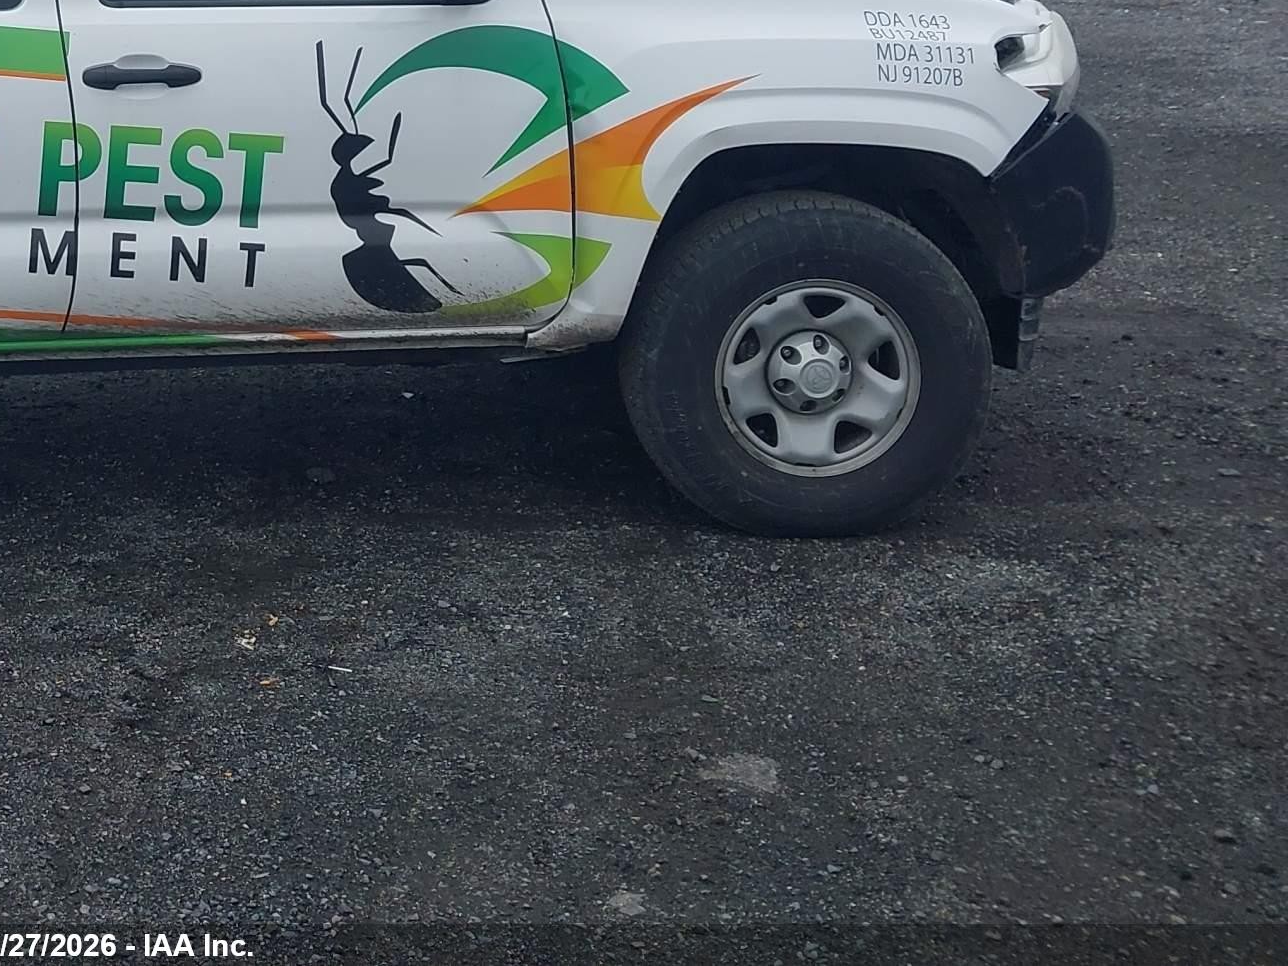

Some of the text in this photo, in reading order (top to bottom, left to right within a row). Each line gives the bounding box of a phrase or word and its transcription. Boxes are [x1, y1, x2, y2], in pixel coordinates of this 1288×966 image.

[864, 11, 950, 29] DDA 1643
[877, 42, 974, 64] MDA 31131
[878, 64, 963, 86] NJ 91207B
[38, 120, 285, 229] PEST
